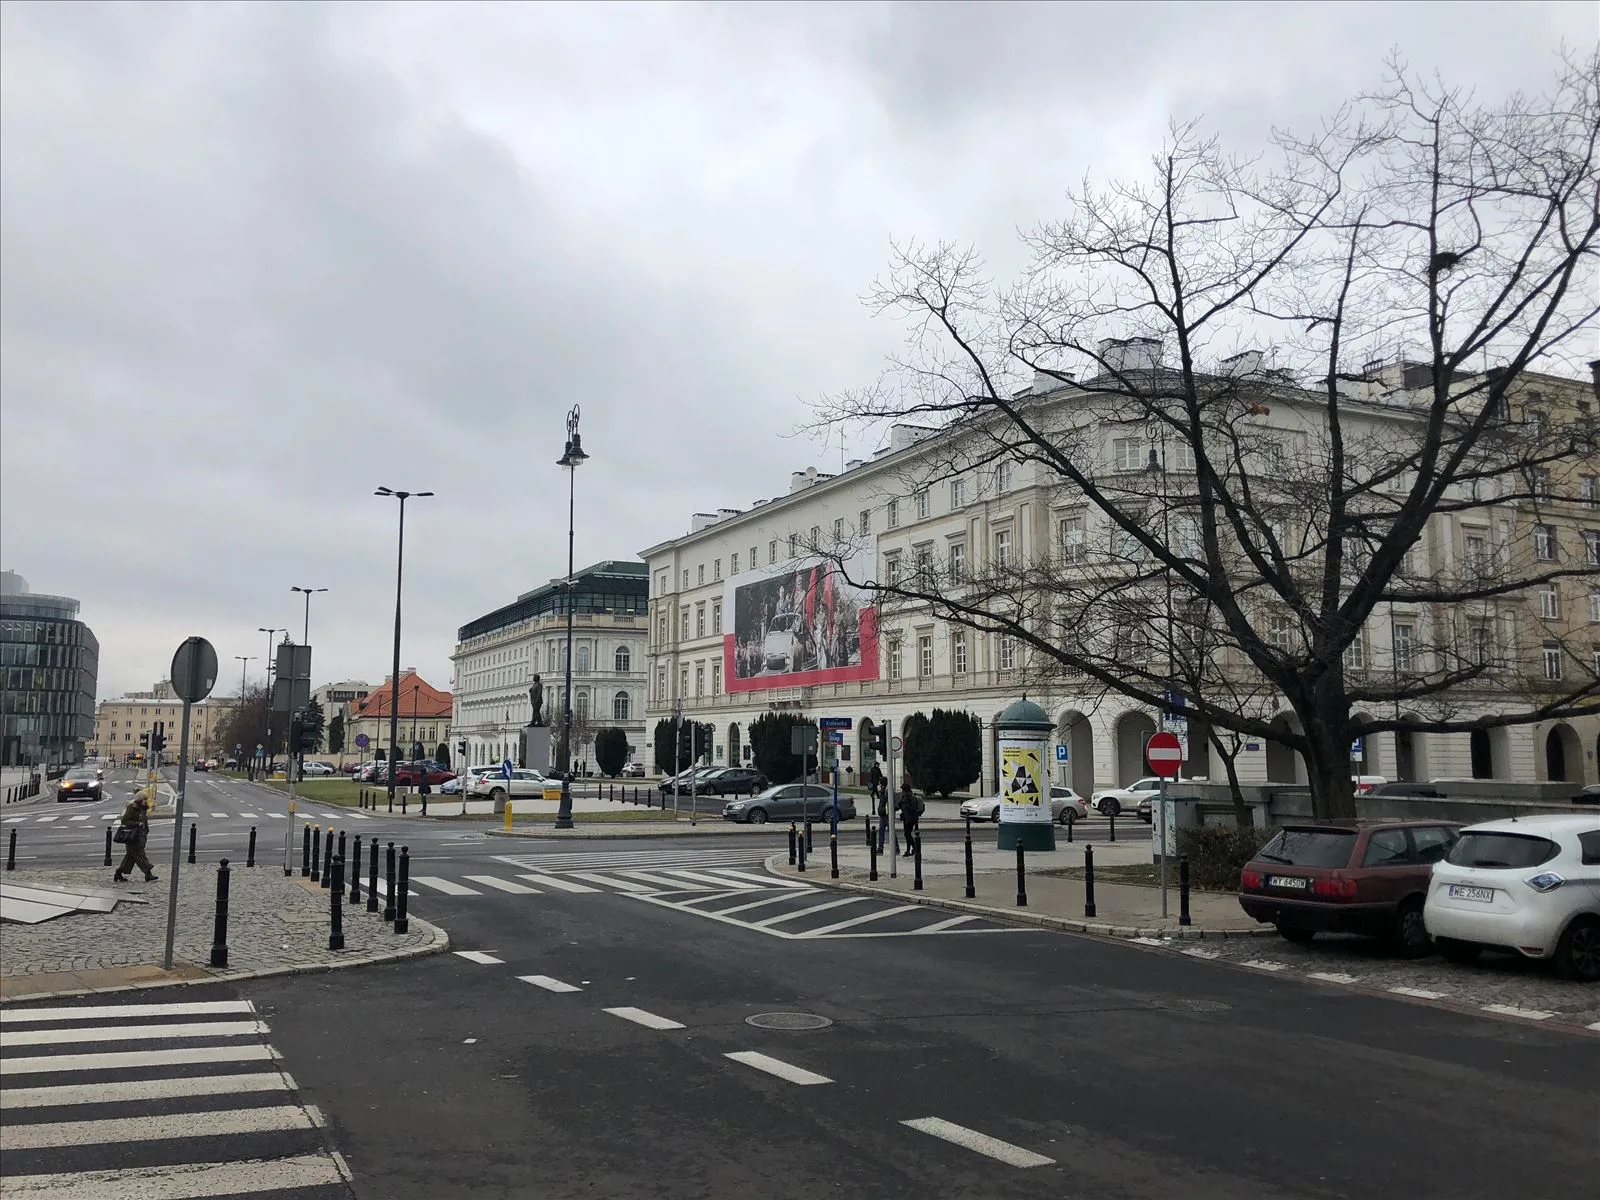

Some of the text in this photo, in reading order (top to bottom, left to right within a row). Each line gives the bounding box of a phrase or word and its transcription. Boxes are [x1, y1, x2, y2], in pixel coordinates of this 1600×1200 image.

[1058, 746, 1066, 759] P
[1454, 887, 1491, 899] WE 256NX
